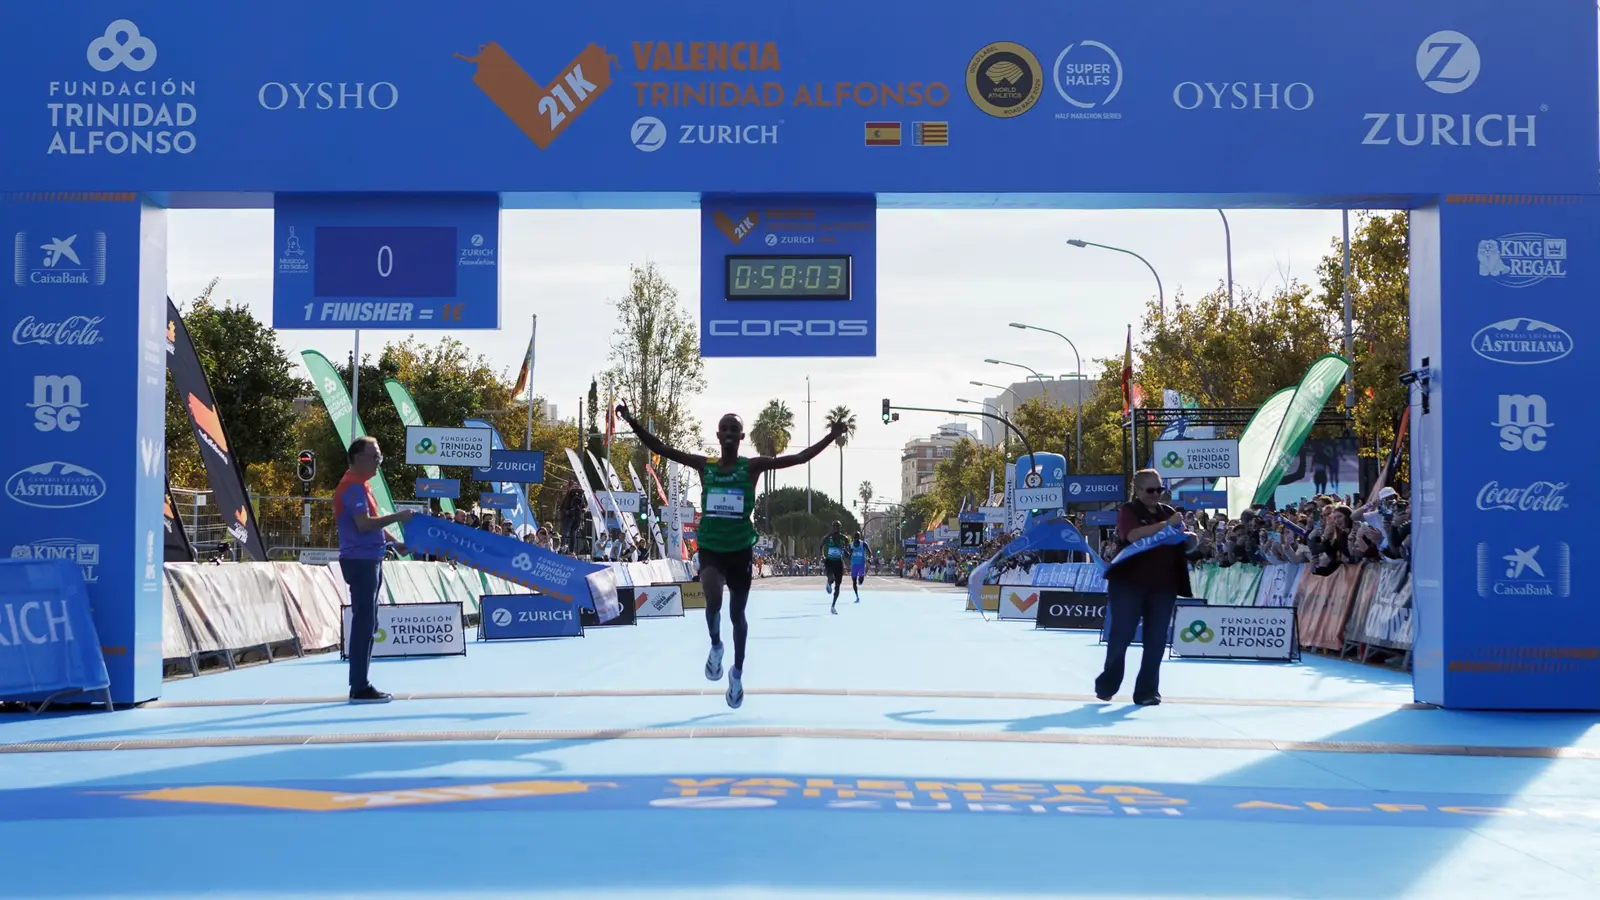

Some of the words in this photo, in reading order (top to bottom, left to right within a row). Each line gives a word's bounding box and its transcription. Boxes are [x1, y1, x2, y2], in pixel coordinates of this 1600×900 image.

[631, 41, 781, 71] VALENCIA
[1066, 63, 1110, 74] SUPER
[50, 78, 196, 97] FUNDACIÓN
[1066, 75, 1110, 86] HALFS
[258, 81, 399, 110] OYSHO
[537, 62, 598, 132] 21K
[632, 81, 785, 108] TRINIDAD
[792, 81, 950, 108] ALFONSO
[1173, 81, 1314, 111] OYSHO
[47, 103, 197, 127] TRINIDAD
[679, 124, 778, 144] ZURICH
[1361, 113, 1537, 147] ZURICH
[47, 131, 197, 155] ALFONSO
[734, 217, 755, 239] 21K
[780, 236, 815, 244] ZURICH
[461, 248, 493, 256] ZURICH
[1500, 240, 1542, 257] KING
[377, 245, 393, 277] 0
[1510, 259, 1566, 276] REGAL
[30, 271, 89, 284] CaixaBank
[734, 265, 842, 290] 0:58:03
[303, 302, 314, 321] 1
[320, 302, 414, 321] FINISHER
[441, 302, 466, 321] 1€
[12, 315, 106, 345] Coca-Cola
[709, 319, 868, 336] COROS
[1480, 334, 1565, 352] ASTURIANA
[440, 442, 483, 451] TRINIDAD
[440, 451, 483, 459] ALFONSO
[1187, 454, 1230, 462] TRINIDAD
[496, 461, 536, 471] ZURICH
[1187, 462, 1230, 470] ALFONSO
[14, 478, 98, 497] ASTURIANA
[1085, 484, 1119, 492] ZURICH
[1019, 493, 1058, 504] OYSHO
[1476, 480, 1569, 512] Coca-Cola
[964, 531, 981, 545] 21
[531, 570, 568, 586] ALFONSO
[535, 562, 572, 579] TRINIDAD
[1494, 583, 1553, 596] CaixaBank
[391, 614, 453, 624] FUNDACIÓN
[518, 610, 573, 622] ZURICH
[1221, 617, 1287, 626] FUNDACIÓN
[390, 623, 453, 635] TRINIDAD
[1220, 626, 1286, 637] TRINIDAD
[391, 634, 454, 645] ALFONSO
[1219, 637, 1286, 648] ALFONSO
